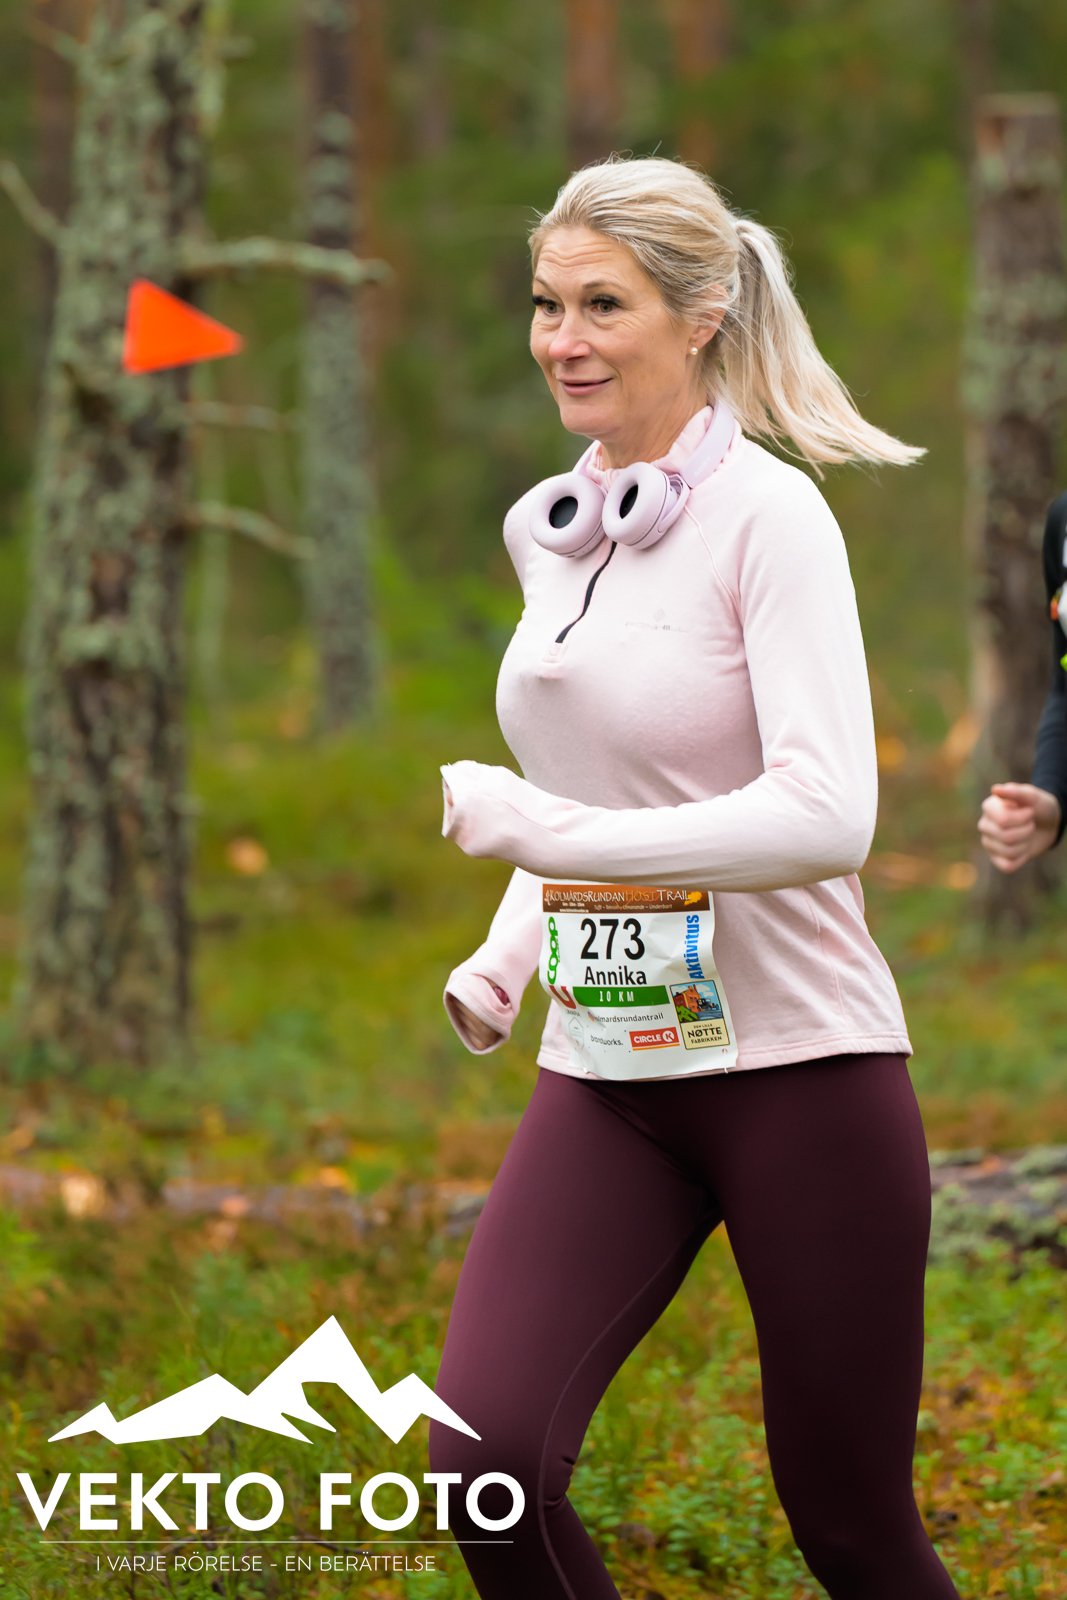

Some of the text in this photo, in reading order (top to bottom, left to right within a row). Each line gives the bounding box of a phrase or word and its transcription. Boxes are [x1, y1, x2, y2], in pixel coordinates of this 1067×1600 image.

[656, 889, 690, 901] TRAIL
[580, 918, 645, 960] 273
[547, 916, 559, 985] coop
[684, 914, 705, 979] Aktivitus
[584, 966, 647, 985] Annika
[599, 990, 635, 1002] 10 KM
[633, 1034, 662, 1044] CIRCLE
[687, 1027, 723, 1039] NØTTE
[691, 1036, 723, 1044] FABRIKKEN
